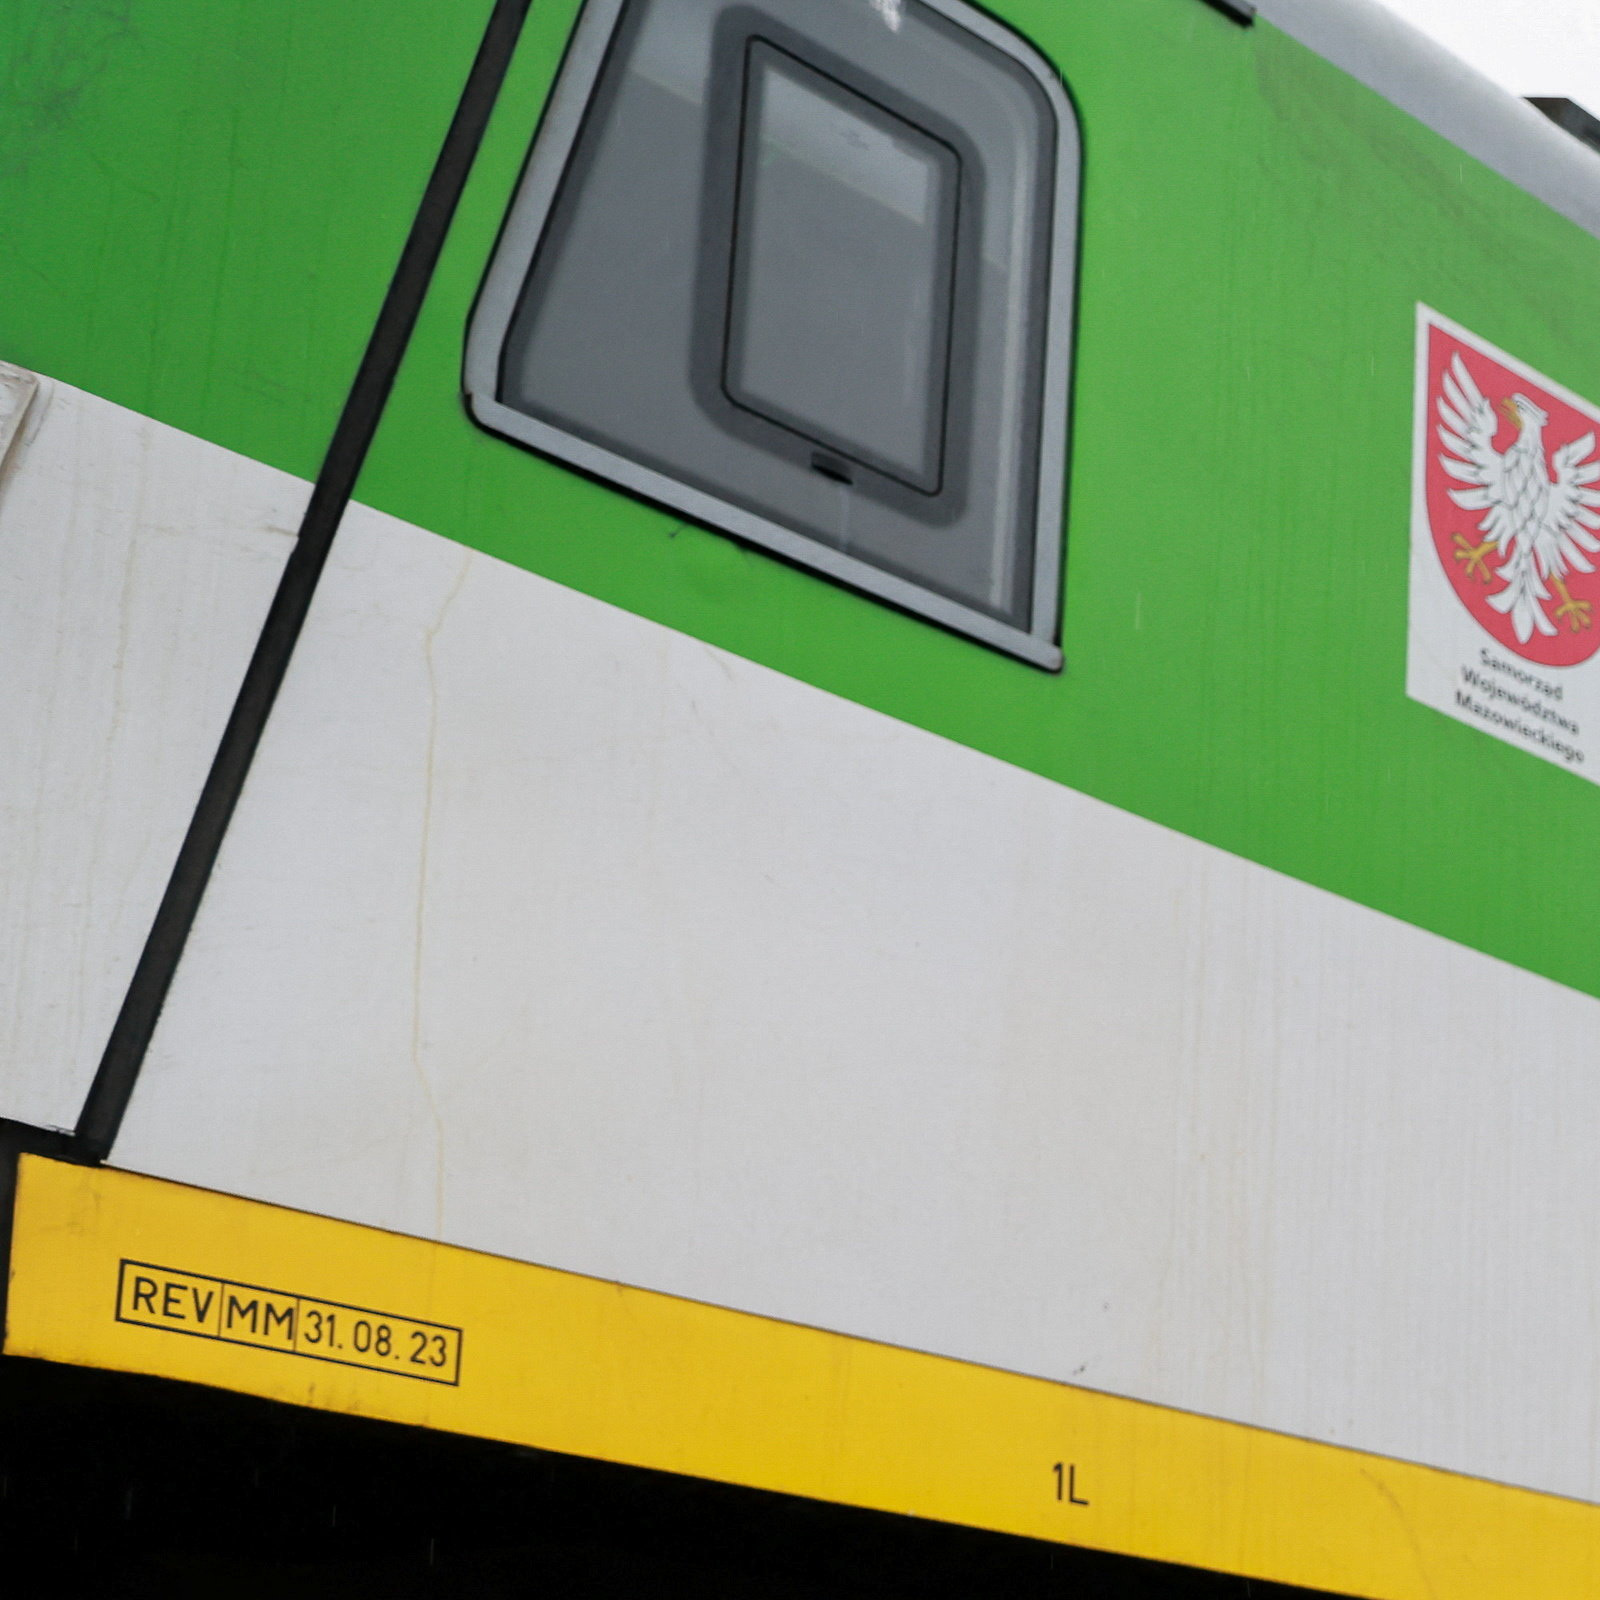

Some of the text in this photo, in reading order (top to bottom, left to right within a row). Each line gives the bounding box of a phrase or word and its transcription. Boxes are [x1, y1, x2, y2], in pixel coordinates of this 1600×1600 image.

[132, 1275, 214, 1323] REV
[226, 1295, 295, 1341] MM
[1053, 1461, 1089, 1505] 1L
